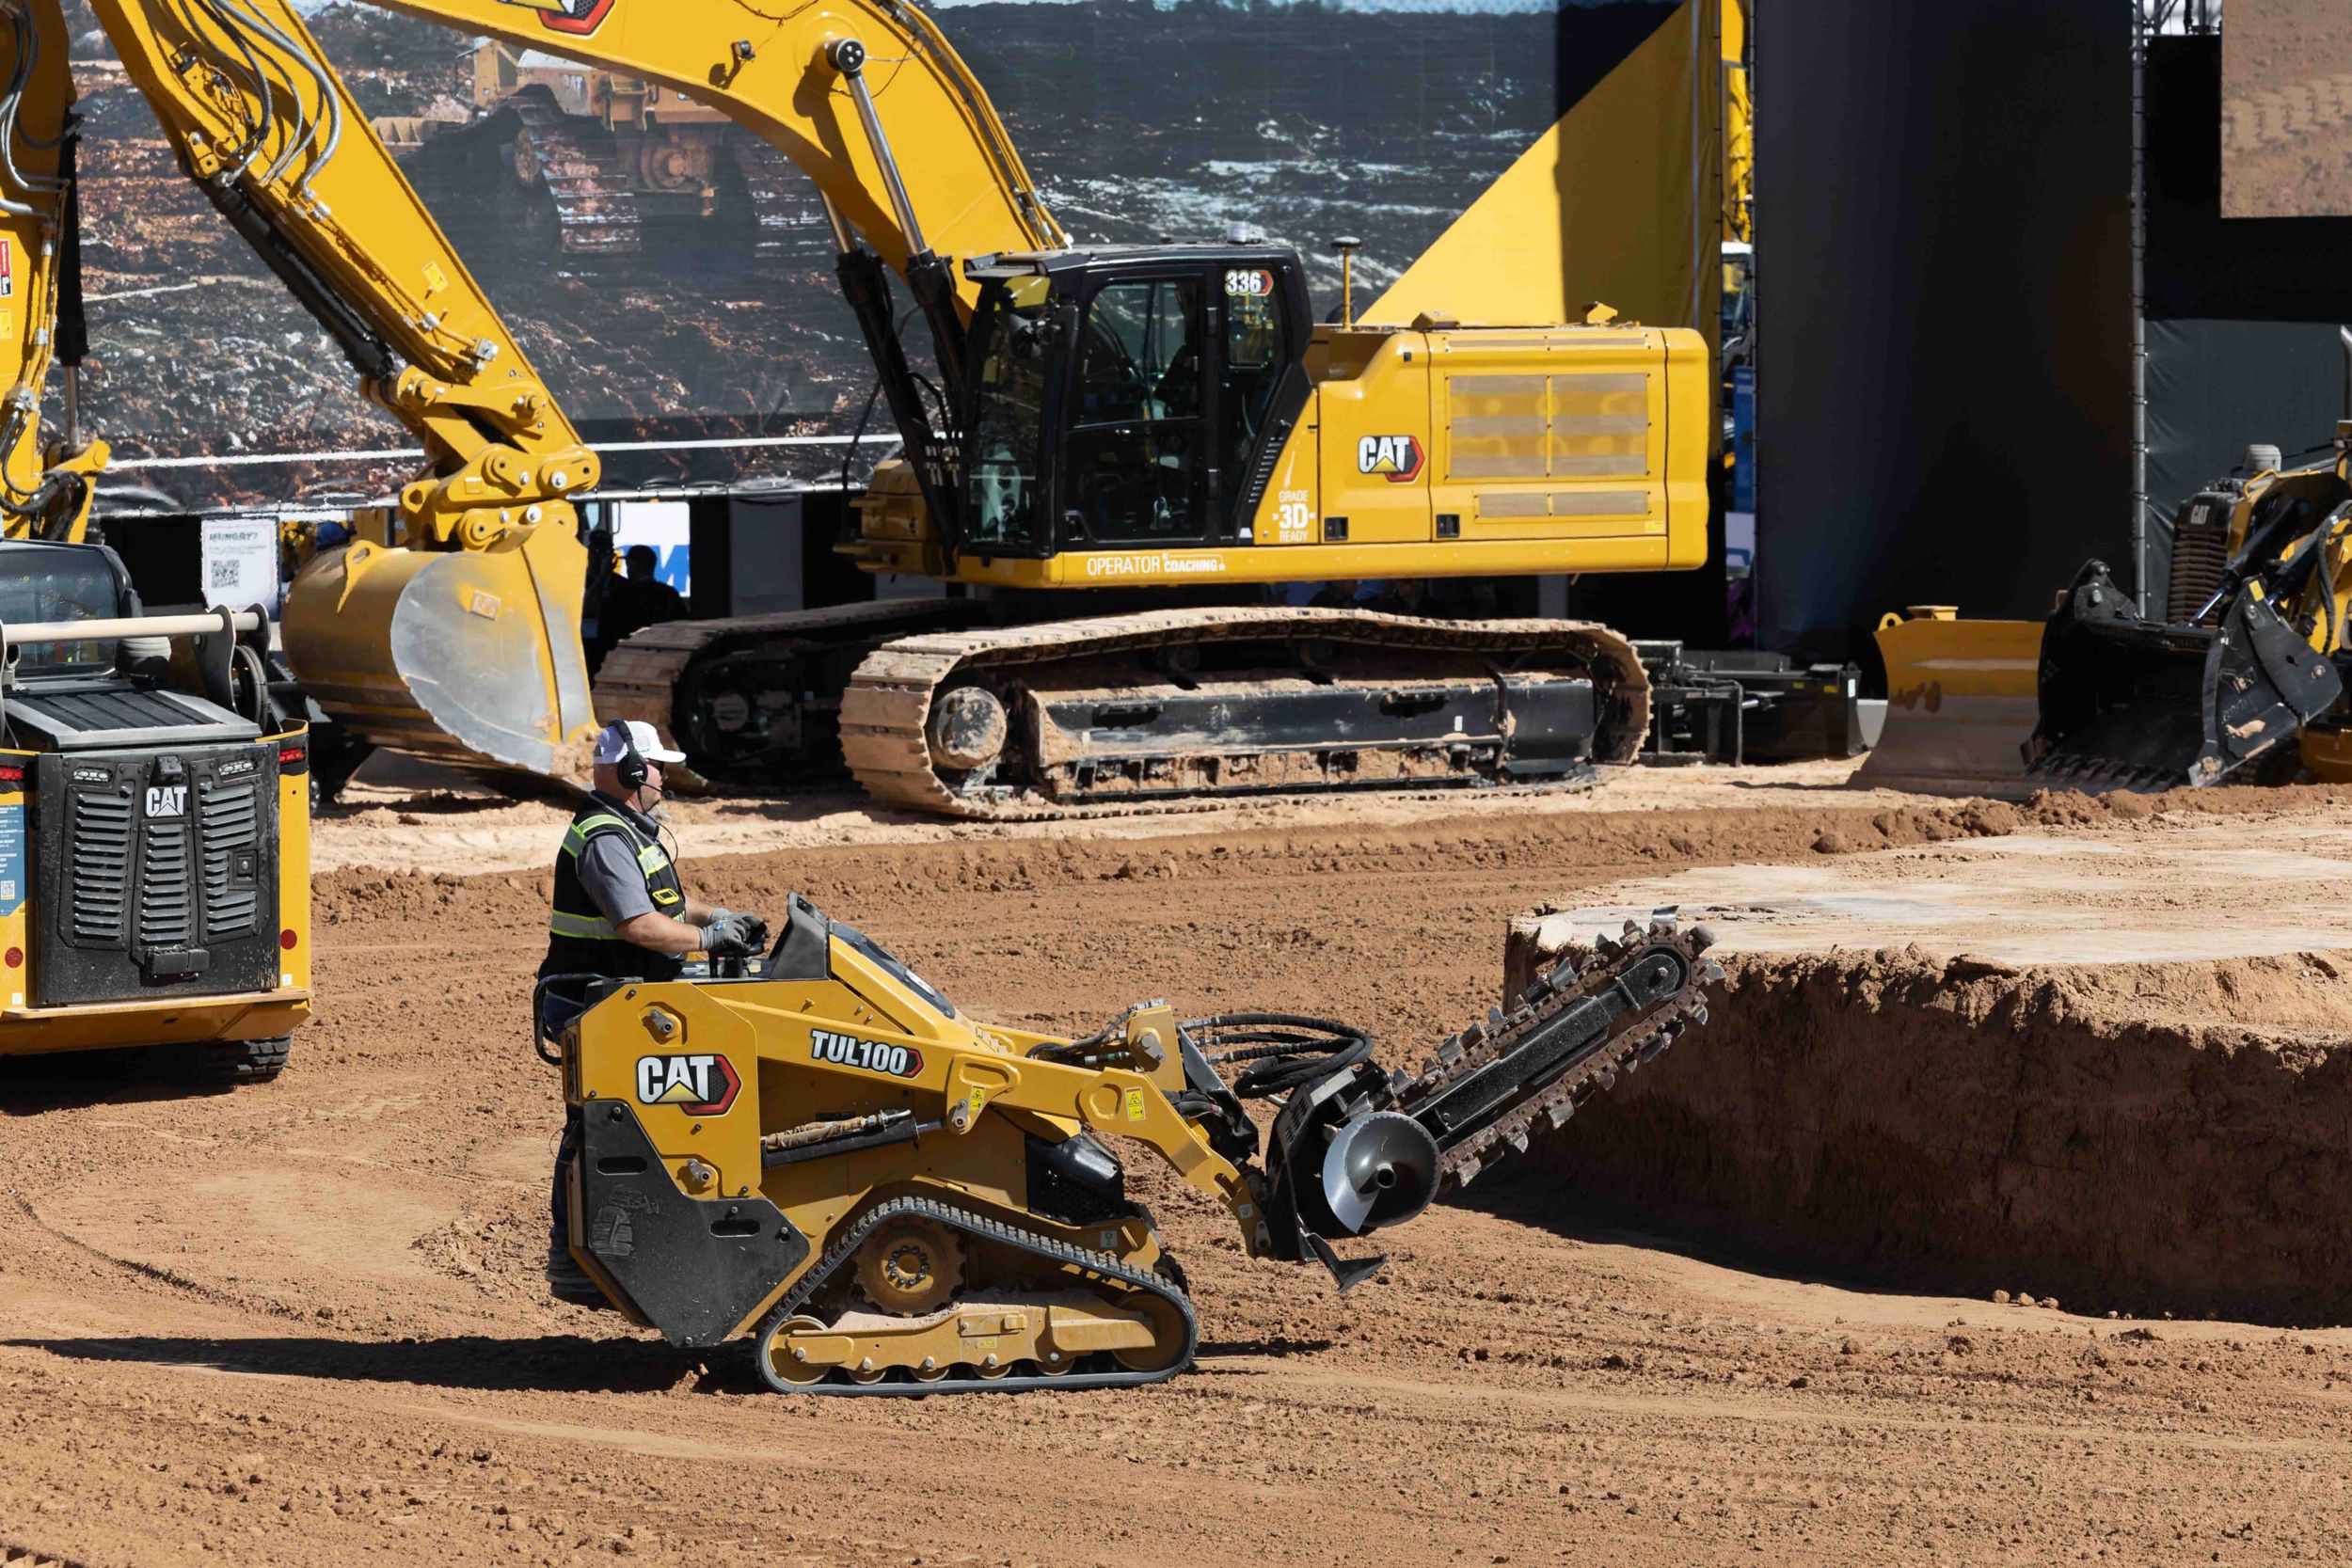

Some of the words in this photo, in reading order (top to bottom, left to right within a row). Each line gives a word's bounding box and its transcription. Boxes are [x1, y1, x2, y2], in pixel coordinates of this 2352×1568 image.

[1226, 271, 1262, 293] 336
[1359, 436, 1410, 473] CAT
[1279, 490, 1309, 502] GRADE
[1279, 503, 1309, 529] 3D
[1279, 530, 1310, 542] READY
[1087, 555, 1161, 576] OPERATOR
[1164, 559, 1218, 573] COACHING
[146, 785, 187, 817] CAT
[811, 1029, 909, 1075] TUL100
[637, 1055, 715, 1102] CAT
